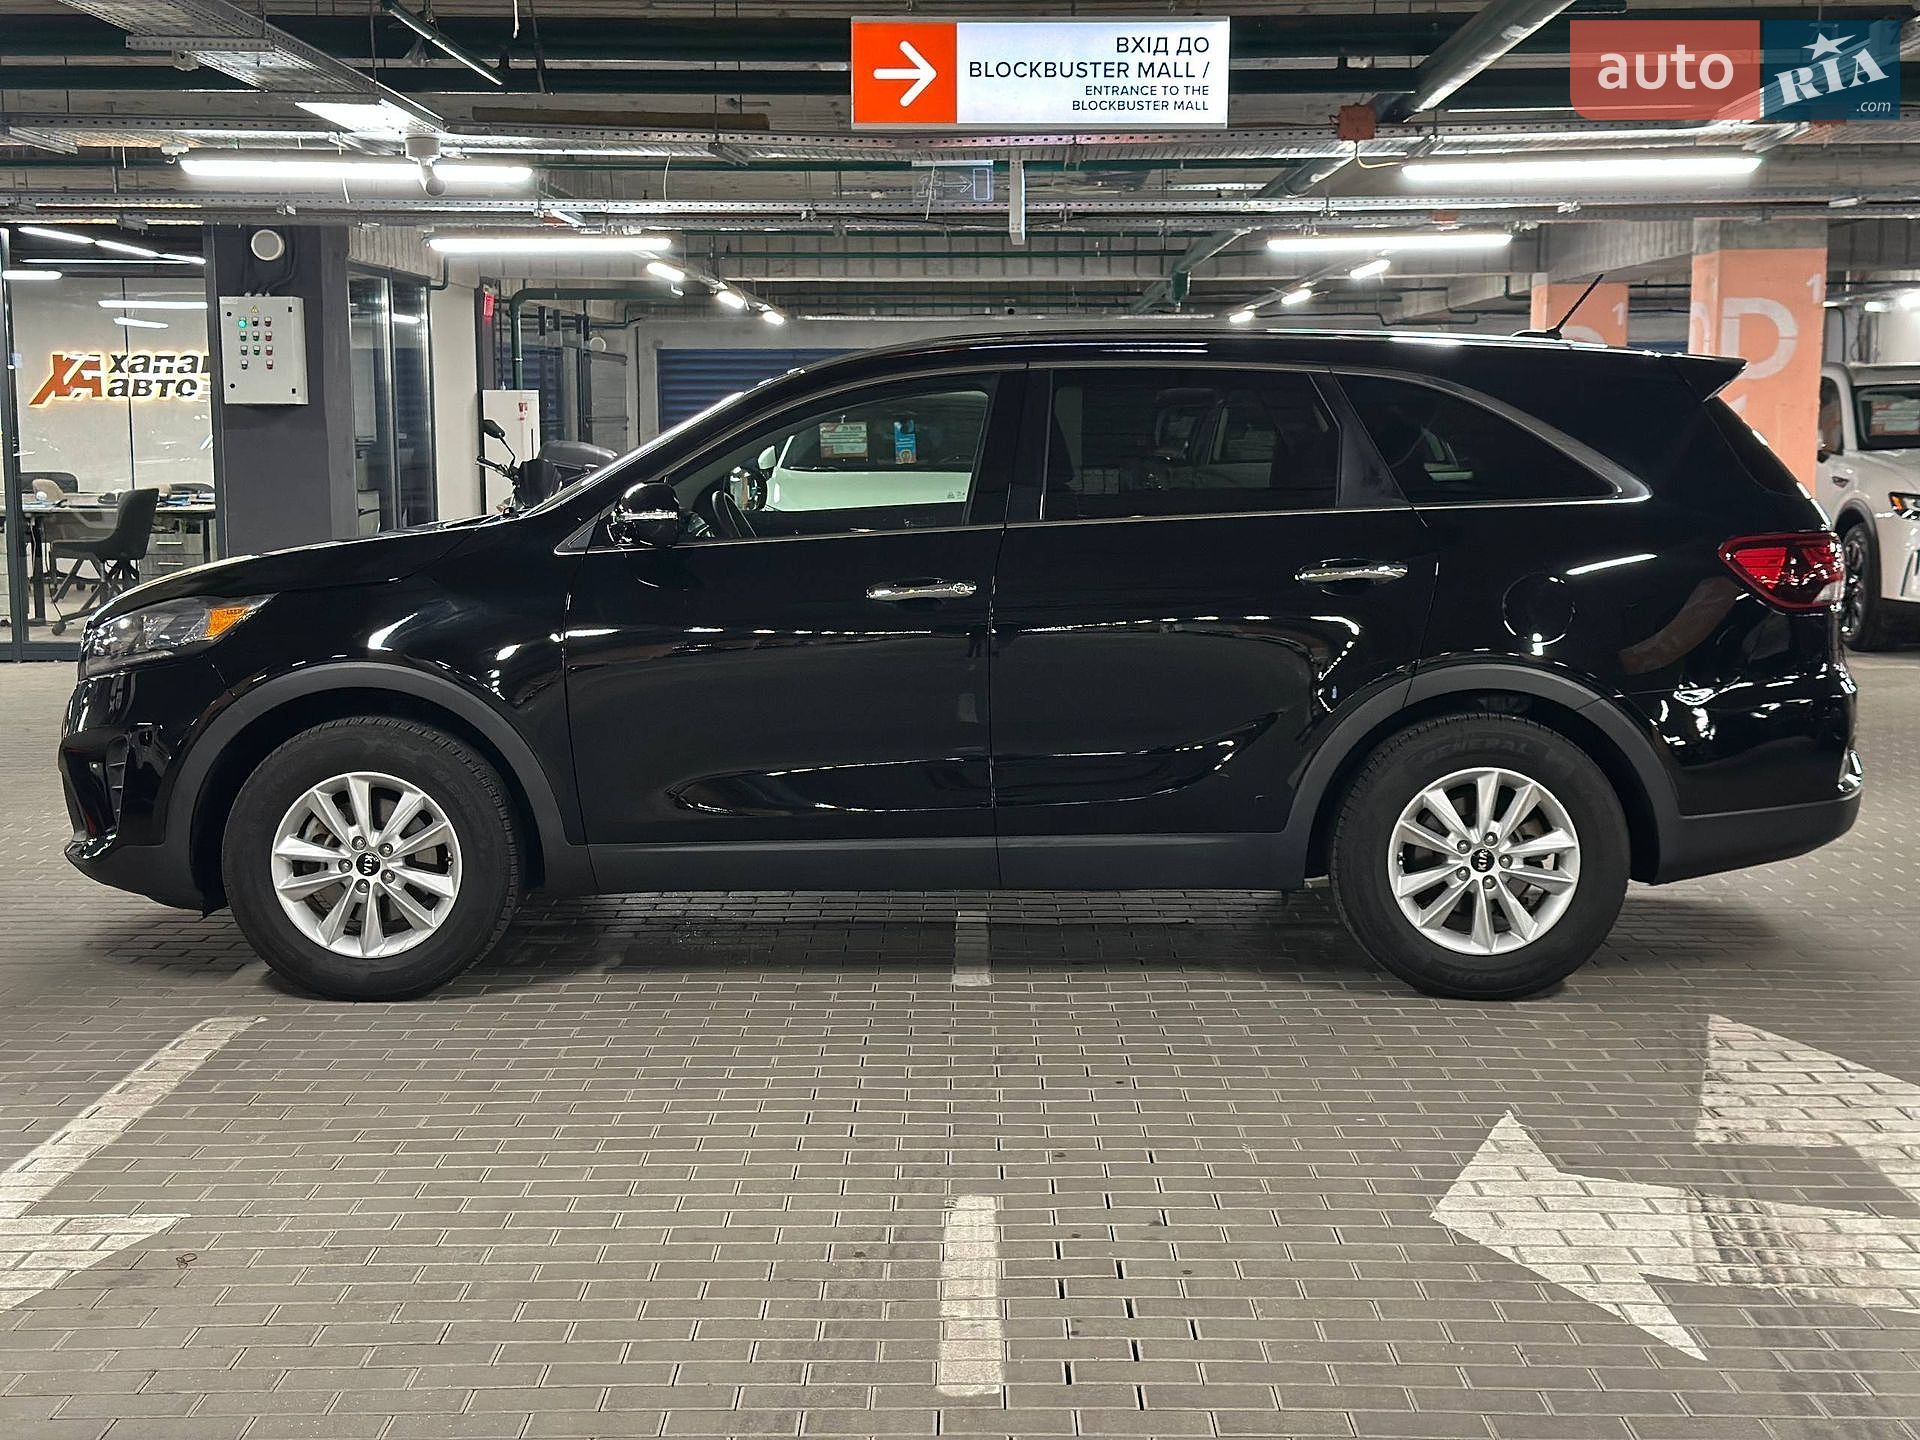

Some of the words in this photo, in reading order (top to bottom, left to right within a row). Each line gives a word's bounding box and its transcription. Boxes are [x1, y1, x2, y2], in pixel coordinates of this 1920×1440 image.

[1116, 36, 1169, 56] ВХІД
[1176, 36, 1210, 56] ДО
[969, 60, 1130, 79] BLOCKBUSTER
[1137, 60, 1197, 79] MALL
[1085, 85, 1157, 96] ENTRANCE
[1161, 85, 1180, 96] TO
[1184, 85, 1209, 96] THE
[1072, 100, 1170, 111] BLOCKBUSTER
[1174, 100, 1209, 111] MALL
[1806, 272, 1822, 305] 1
[1721, 297, 1799, 380] D
[106, 377, 199, 398] авто
